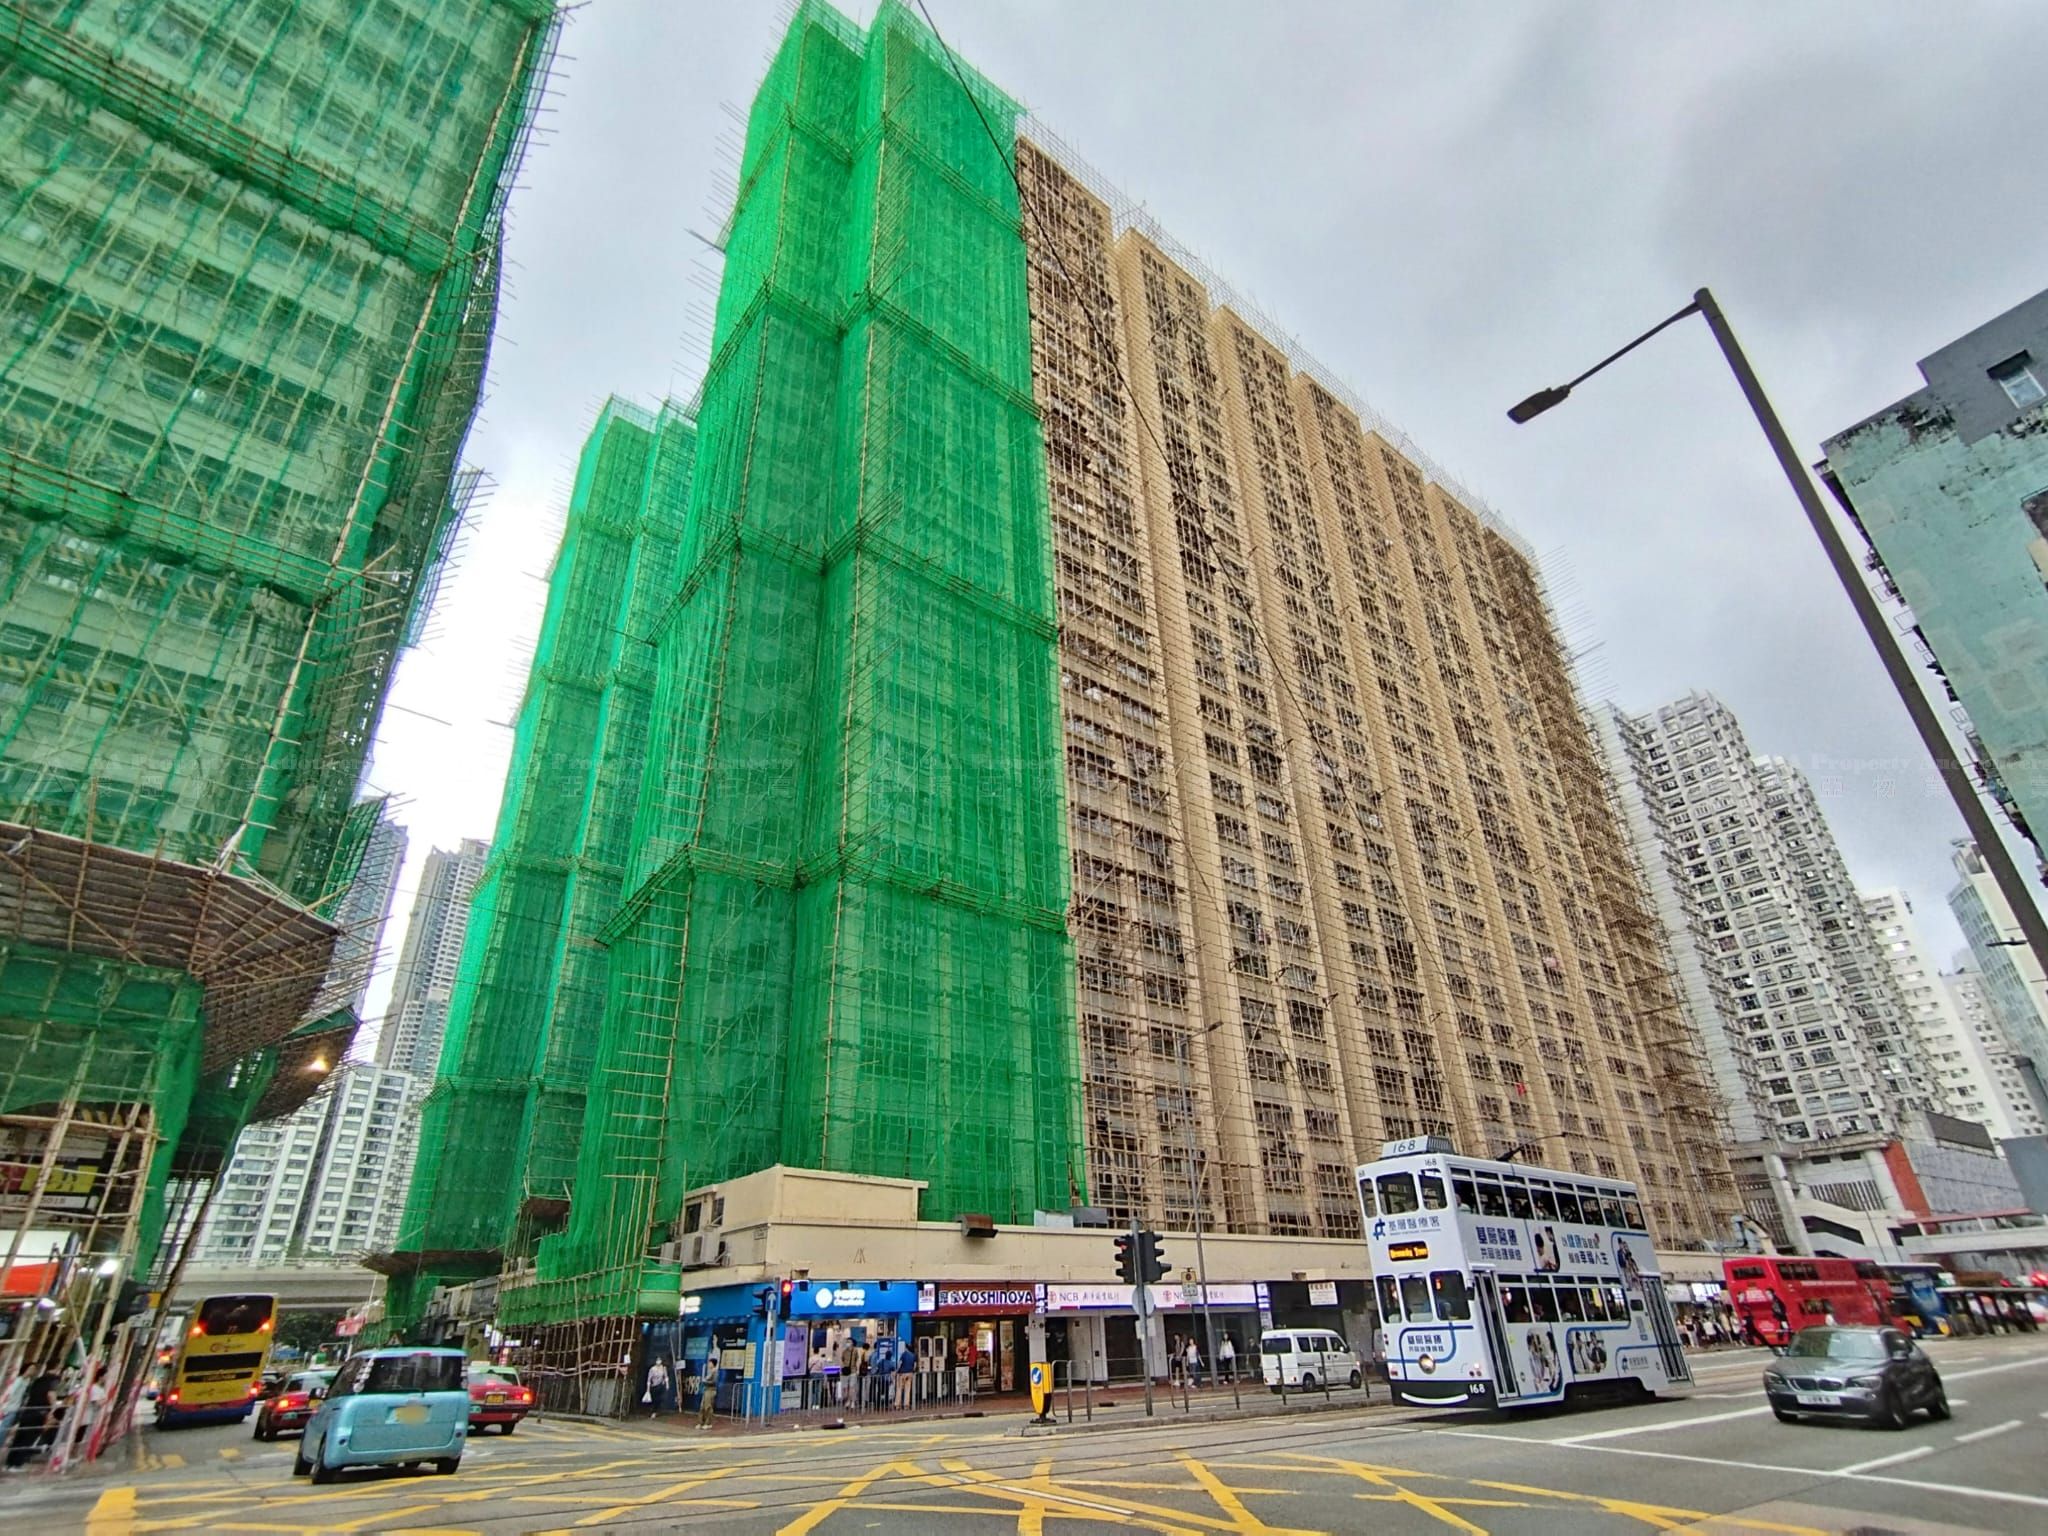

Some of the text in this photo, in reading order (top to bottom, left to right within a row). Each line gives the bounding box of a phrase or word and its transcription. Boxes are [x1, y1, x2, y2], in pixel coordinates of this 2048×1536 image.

[1392, 1139, 1416, 1153] 168
[1425, 1158, 1437, 1166] 168
[961, 1290, 1034, 1304] YOSHINOYA
[1059, 1292, 1079, 1302] NCB
[1469, 1384, 1486, 1394] 168
